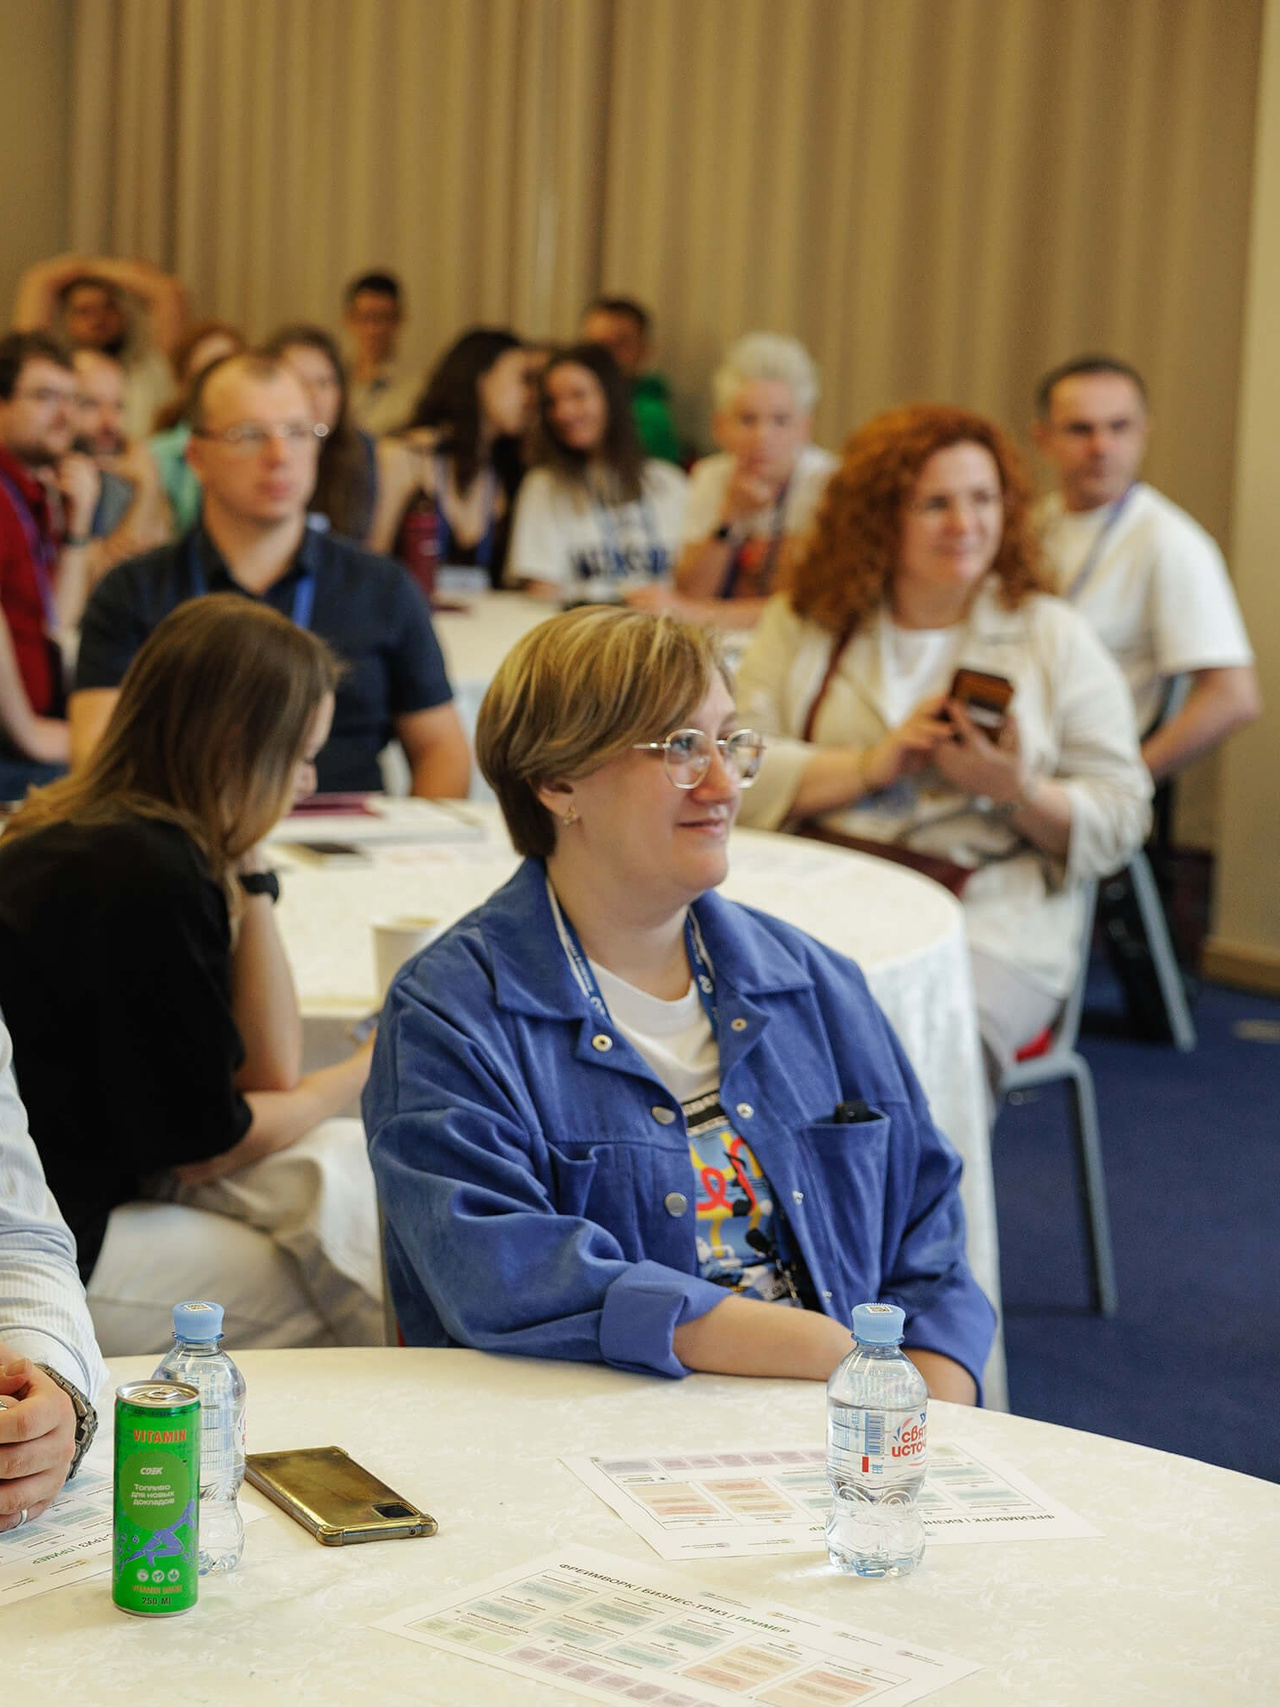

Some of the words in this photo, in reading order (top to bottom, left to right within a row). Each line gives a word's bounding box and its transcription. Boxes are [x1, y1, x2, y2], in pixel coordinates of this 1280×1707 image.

[133, 1429, 186, 1443] VITAMIN
[142, 1597, 158, 1605] 250
[641, 1588, 728, 1617] БИЗНЕС-ТРИЗ
[734, 1616, 791, 1634] ПРИМЕР
